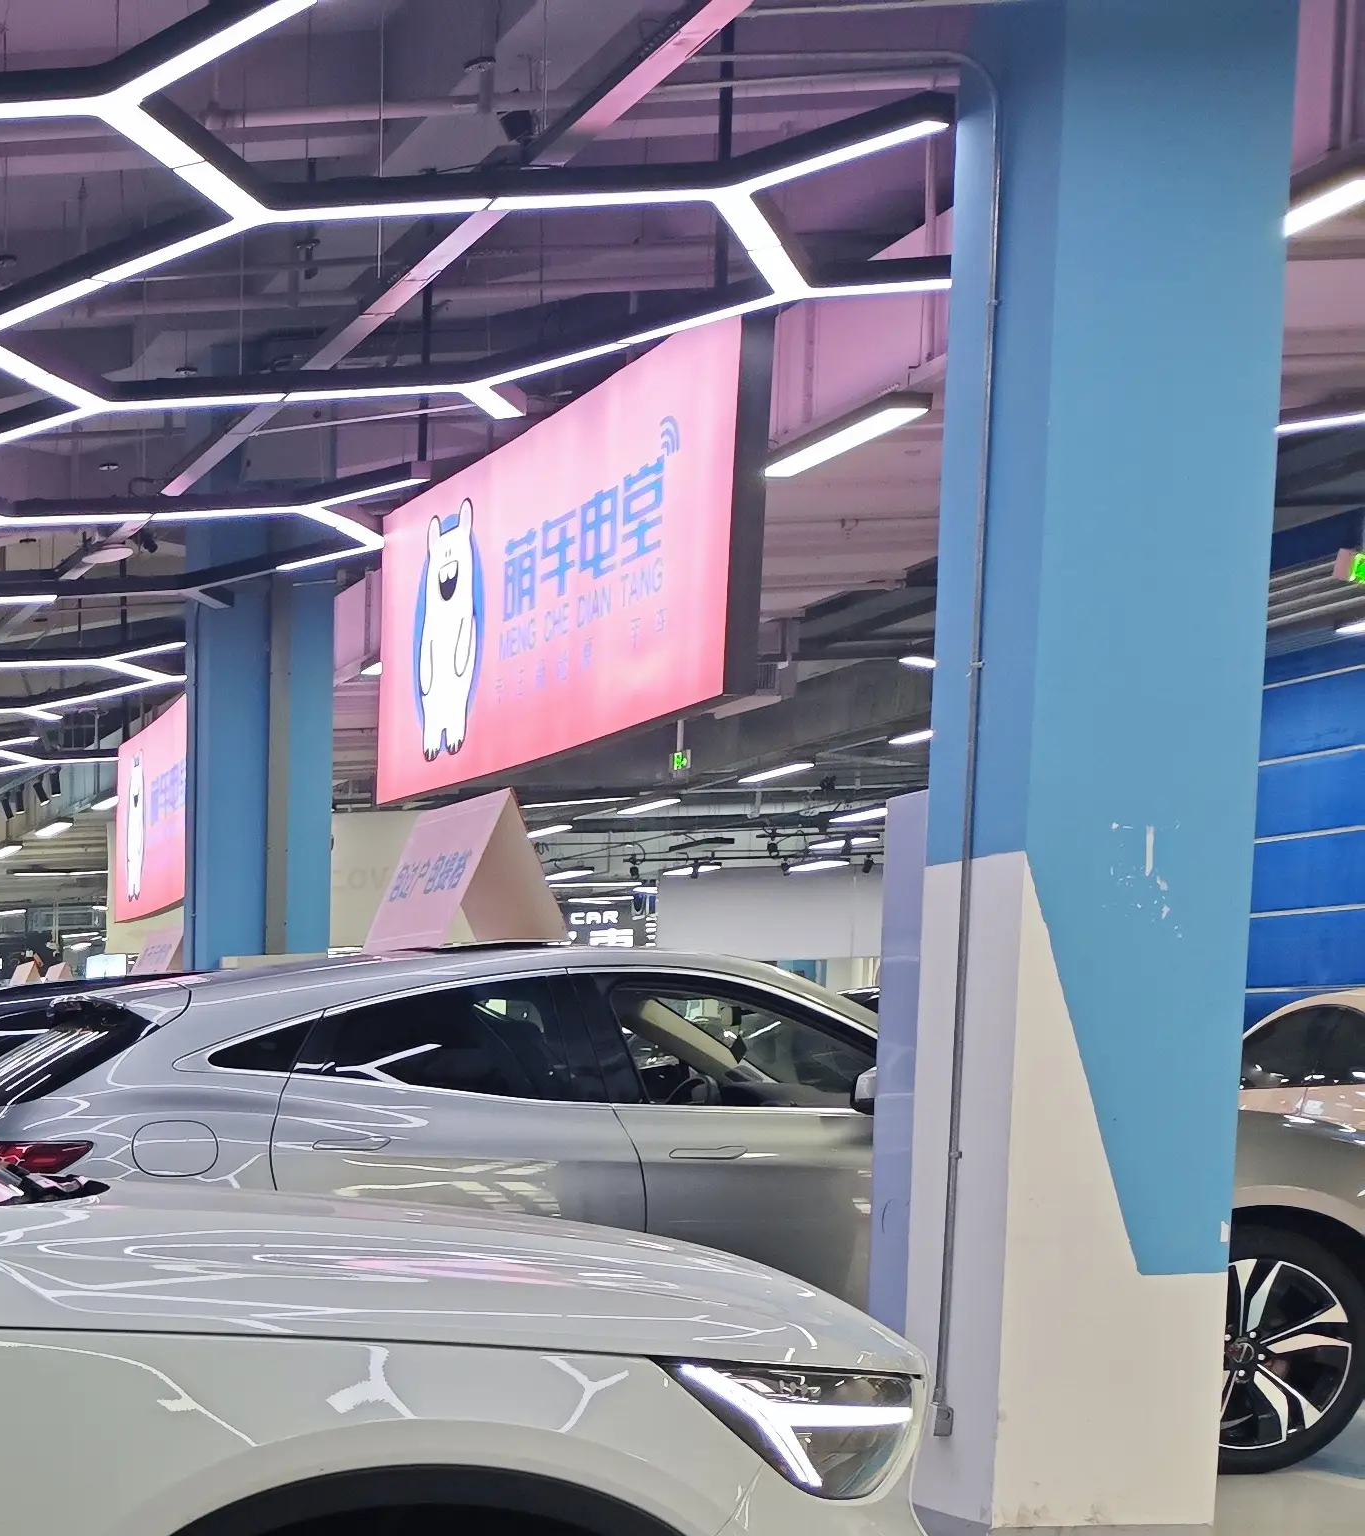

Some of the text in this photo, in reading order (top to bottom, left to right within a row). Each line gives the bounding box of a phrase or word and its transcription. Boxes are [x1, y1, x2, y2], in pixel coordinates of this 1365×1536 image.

[503, 454, 665, 622] 萌车电堂
[498, 557, 664, 661] MENG CHE DIAN TANG
[570, 911, 619, 924] CAR
